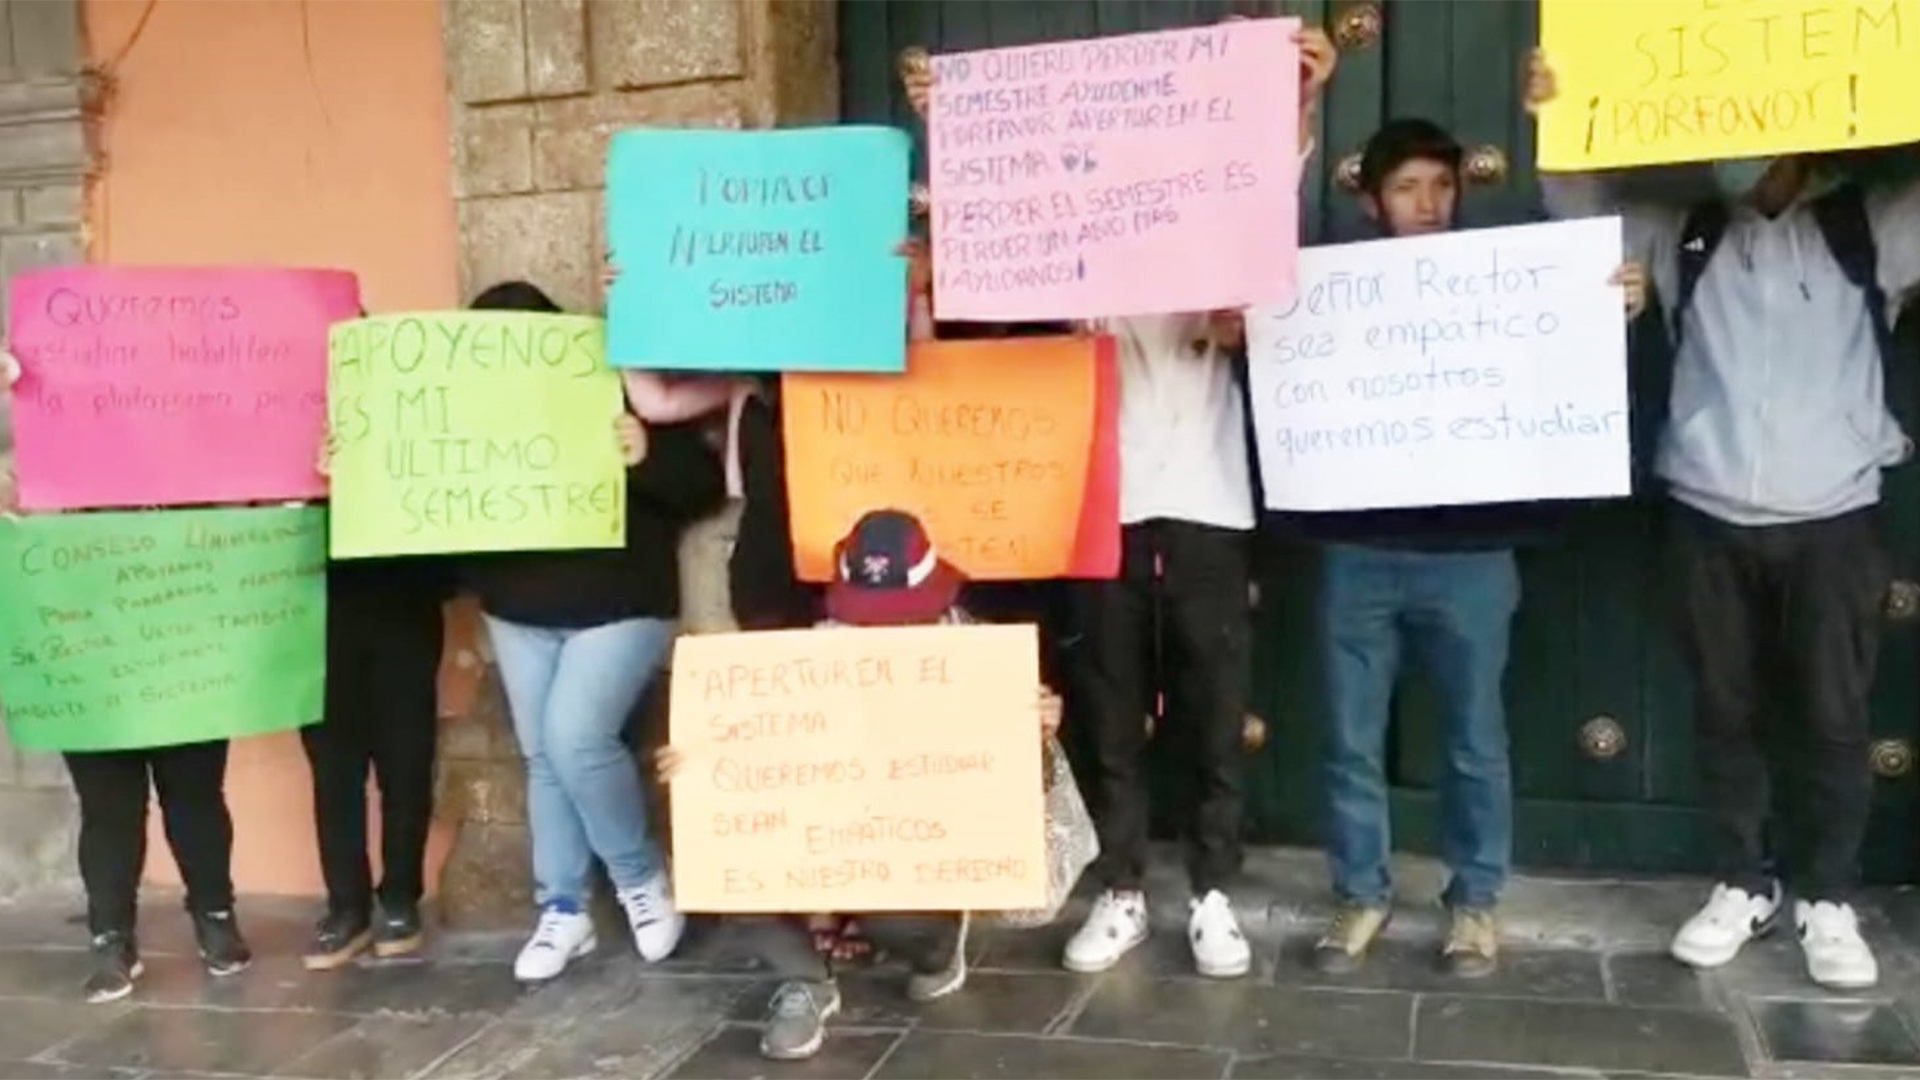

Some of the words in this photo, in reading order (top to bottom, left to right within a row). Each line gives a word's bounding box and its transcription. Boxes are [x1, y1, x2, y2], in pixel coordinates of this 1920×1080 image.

[936, 56, 971, 84] NO
[981, 46, 1073, 80] QUIERO
[1081, 38, 1180, 72] PERDER
[1187, 32, 1229, 62] MI
[938, 83, 1052, 119] SEMESTRE
[1068, 104, 1198, 134] APERTUREN
[1207, 97, 1234, 123] EL
[940, 150, 1049, 188] SISTEMA
[941, 198, 1044, 232] PERDER
[1051, 190, 1078, 219] EL
[1086, 168, 1207, 215] SEMESTRE
[1222, 160, 1259, 190] ES
[940, 234, 1031, 264] PERDER
[709, 277, 798, 309] SISTEMA
[1415, 248, 1559, 298] Rector
[1365, 308, 1559, 356] empático
[1275, 382, 1329, 409] con
[1347, 356, 1507, 402] nosotros
[336, 396, 370, 446] ES
[396, 385, 451, 434] MI
[821, 390, 867, 436] NO
[1276, 414, 1436, 467] queremos
[1447, 401, 1623, 442] estudiar
[386, 435, 560, 480] ULTIMO
[918, 656, 954, 684] EL
[712, 756, 866, 793] QUEREMOS
[713, 808, 788, 837] SEAN
[724, 866, 765, 894] ES
[786, 858, 891, 890] NUESTRO
[914, 856, 1026, 885] DERECHO
